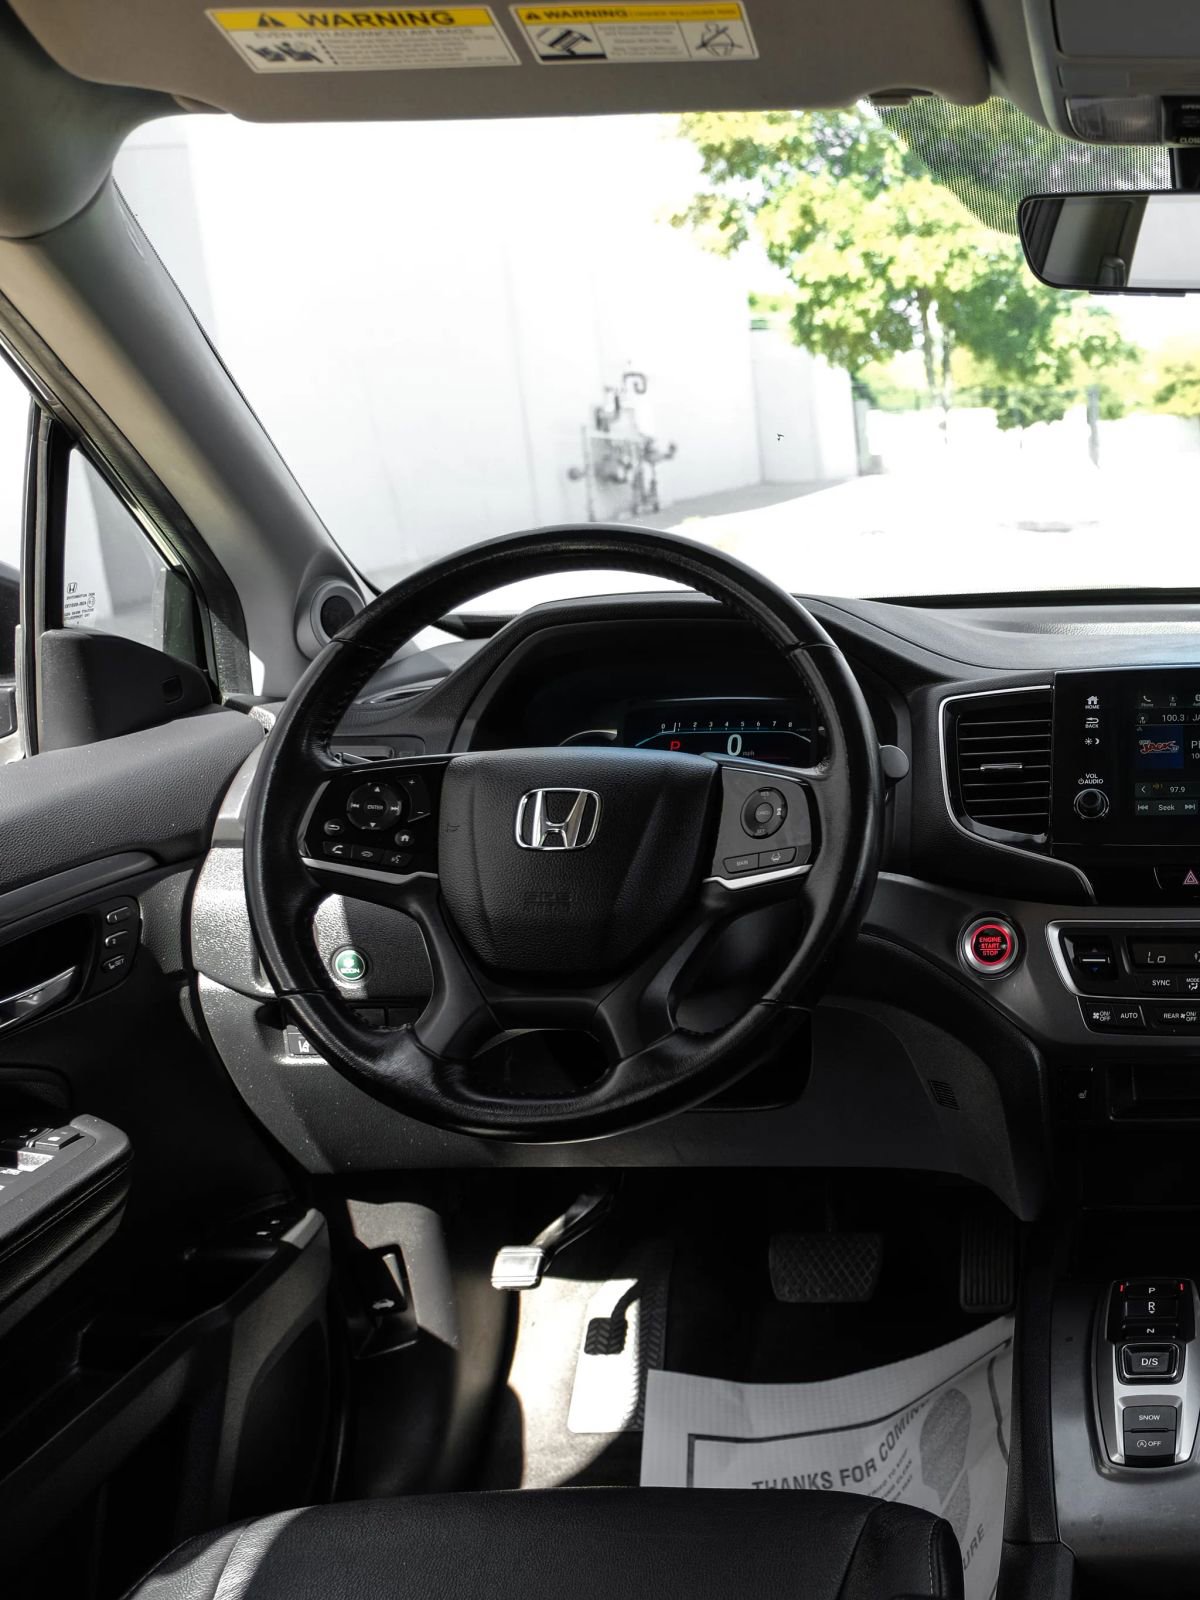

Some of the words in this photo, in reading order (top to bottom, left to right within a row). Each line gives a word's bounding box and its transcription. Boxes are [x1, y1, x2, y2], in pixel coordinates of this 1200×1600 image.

[299, 10, 455, 27] WARNING
[544, 9, 628, 19] WARNING
[1162, 714, 1185, 722] 100.3
[670, 740, 681, 751] P
[727, 733, 743, 756] 0
[1148, 1301, 1156, 1311] R
[1141, 1357, 1159, 1366] D/S
[840, 1458, 879, 1486] FOR
[878, 1399, 929, 1462] COMIN
